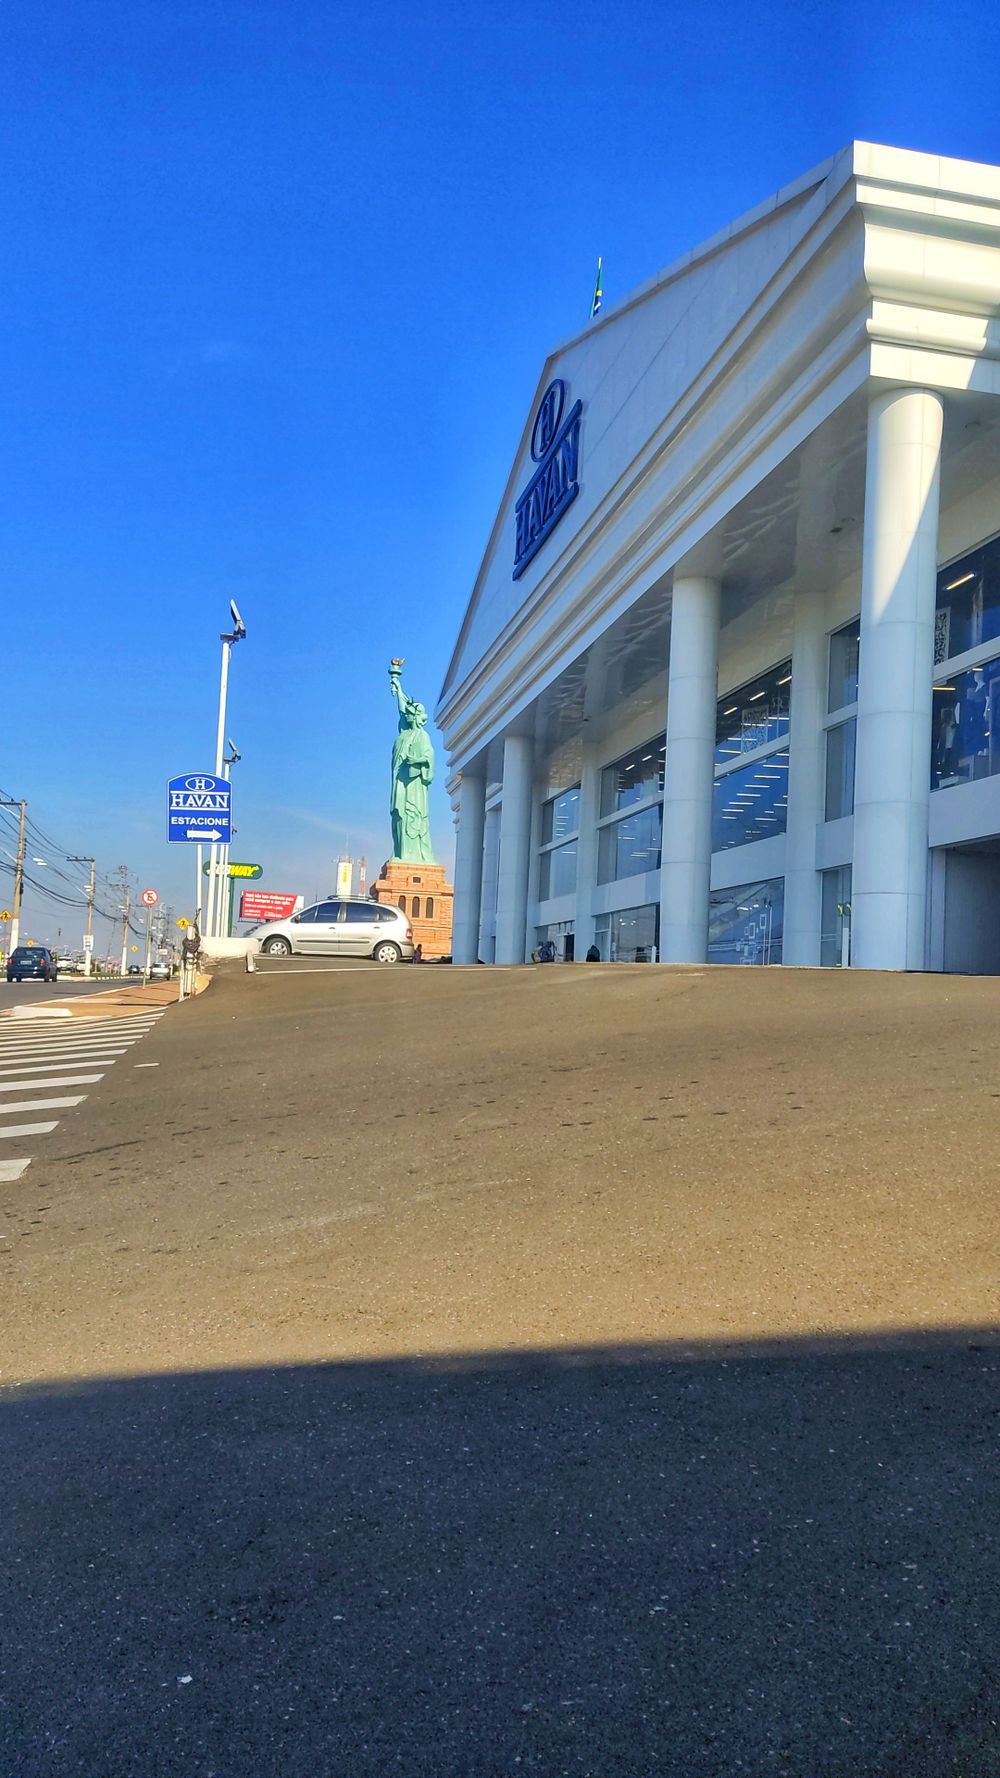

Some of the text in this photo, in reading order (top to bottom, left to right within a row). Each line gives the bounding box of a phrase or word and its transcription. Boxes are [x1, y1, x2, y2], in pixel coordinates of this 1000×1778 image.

[540, 391, 556, 452] H
[514, 419, 580, 566] HAVAN
[195, 779, 206, 790] H
[171, 794, 229, 808] HAVAN
[171, 816, 229, 826] ESTACIONE
[206, 864, 259, 876] UBWAY
